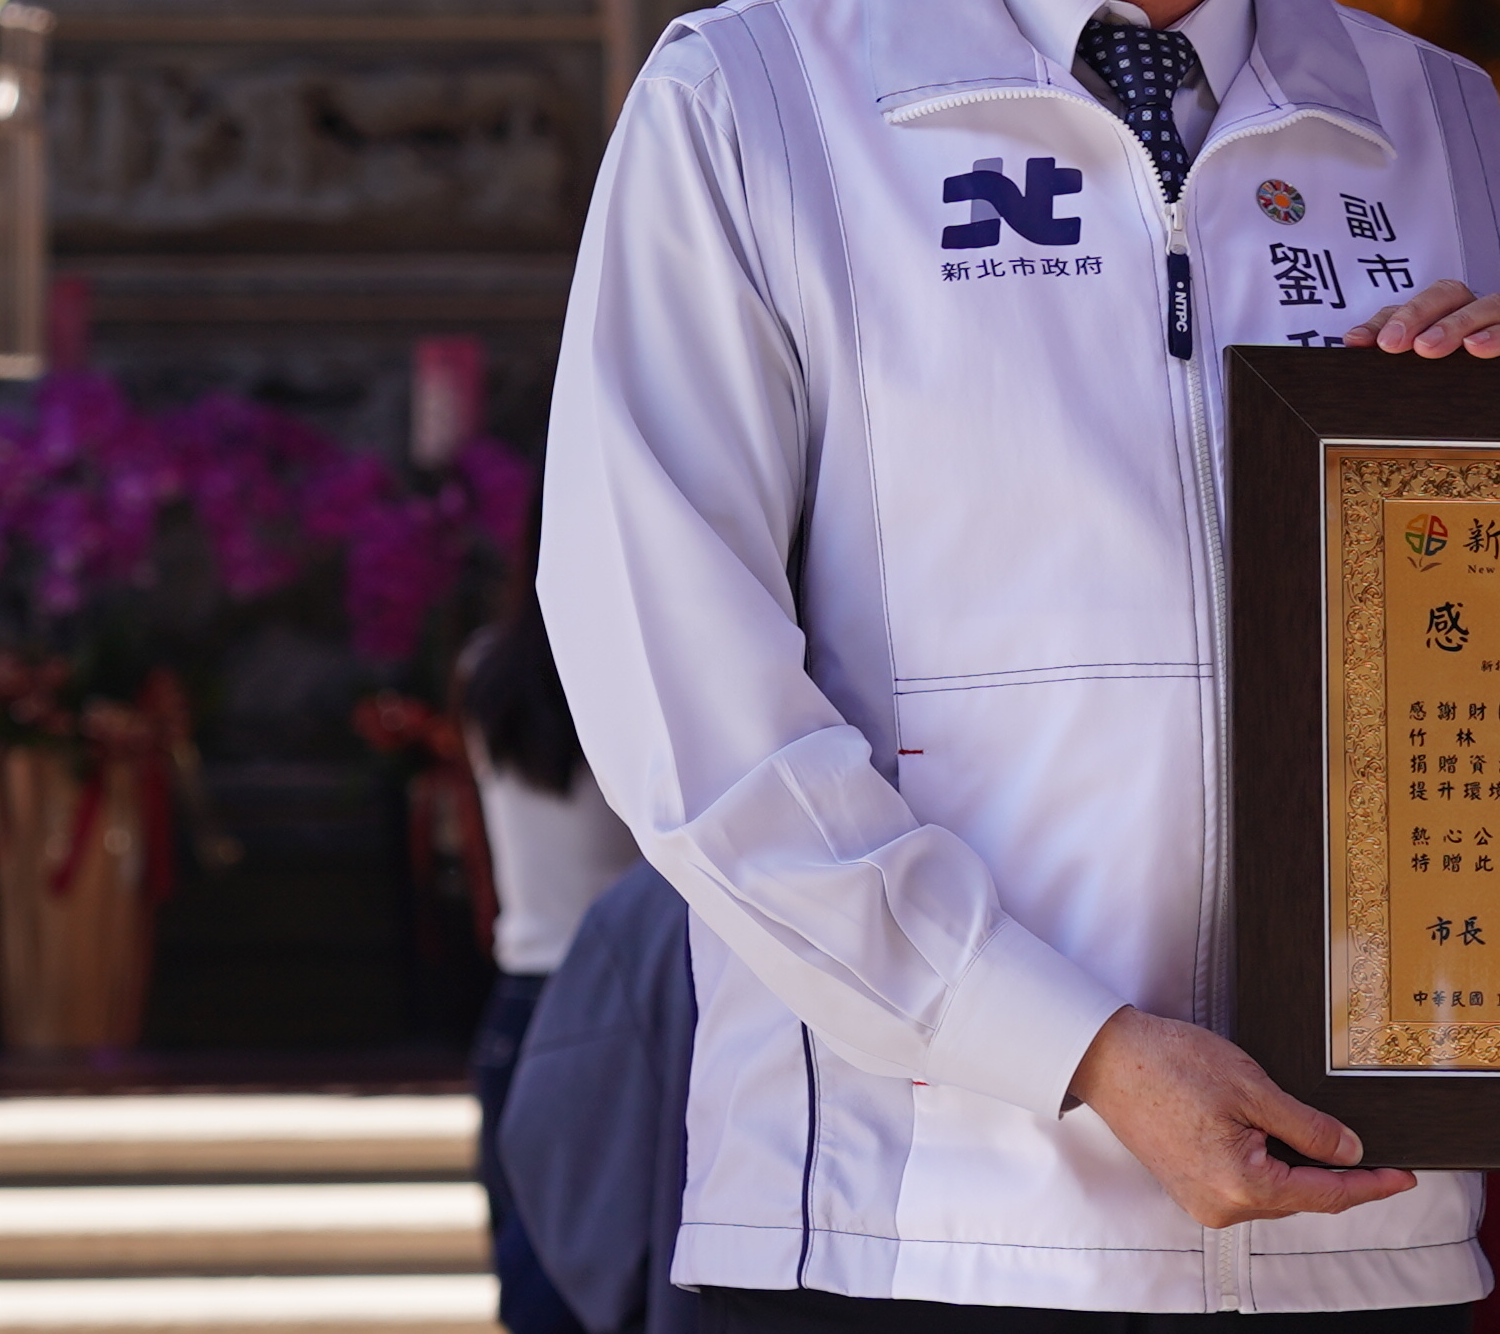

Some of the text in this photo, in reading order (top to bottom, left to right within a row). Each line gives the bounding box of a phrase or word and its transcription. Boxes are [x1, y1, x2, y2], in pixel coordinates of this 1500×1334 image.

[1334, 192, 1415, 296] 副市
[941, 255, 1103, 282] 新北市政府
[1265, 239, 1350, 347] 劉
[1174, 290, 1190, 334] NTPC
[1467, 564, 1496, 575] New
[1425, 915, 1486, 947] 市長
[1412, 989, 1485, 1009] 中華民國
